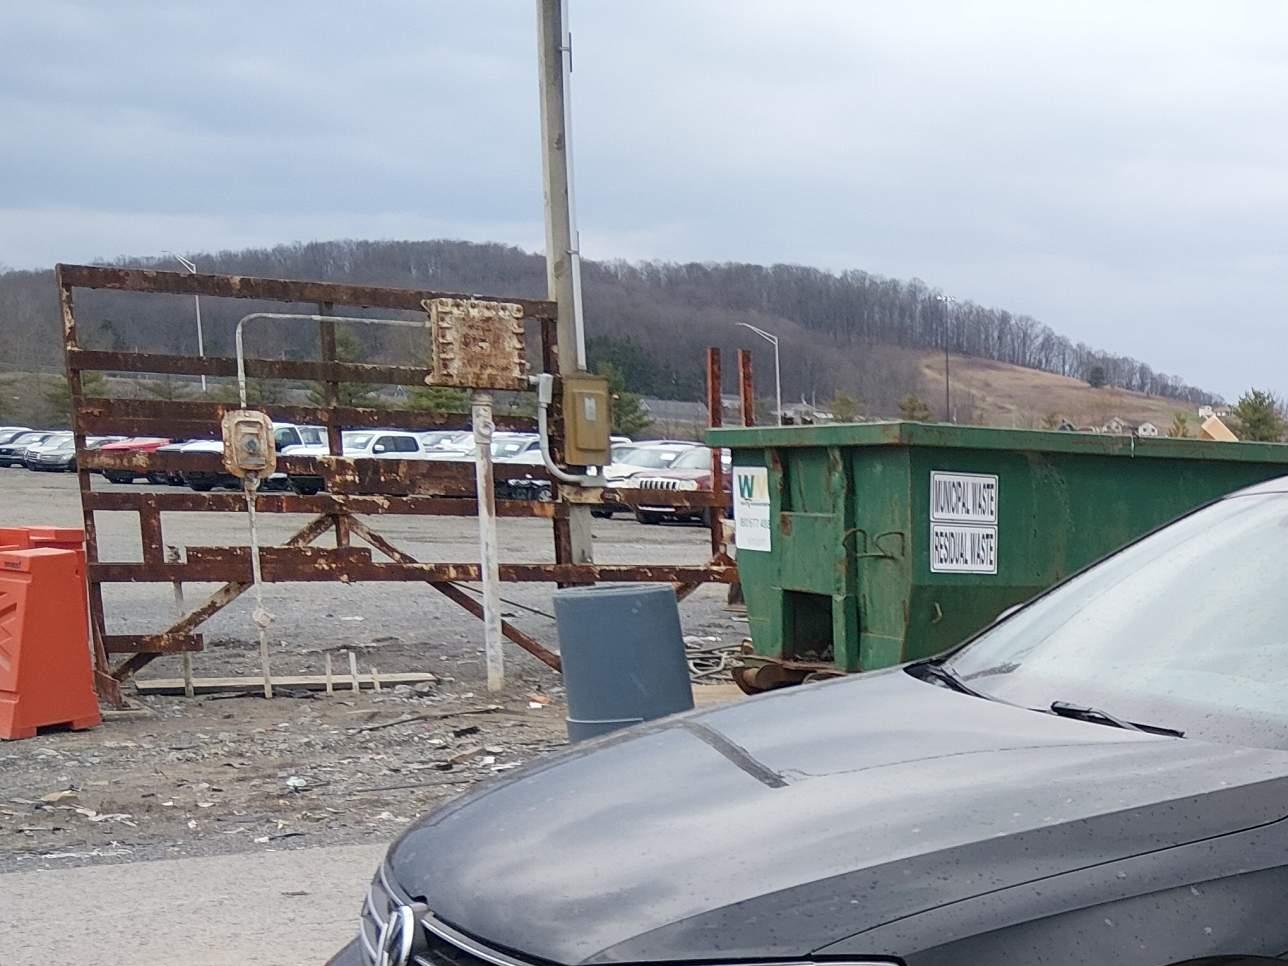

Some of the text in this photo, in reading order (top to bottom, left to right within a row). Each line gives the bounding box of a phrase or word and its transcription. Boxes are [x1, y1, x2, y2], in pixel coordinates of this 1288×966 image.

[934, 479, 994, 517] MUNICIPAL WASTE
[934, 531, 993, 566] RESIDUAL WASTE
